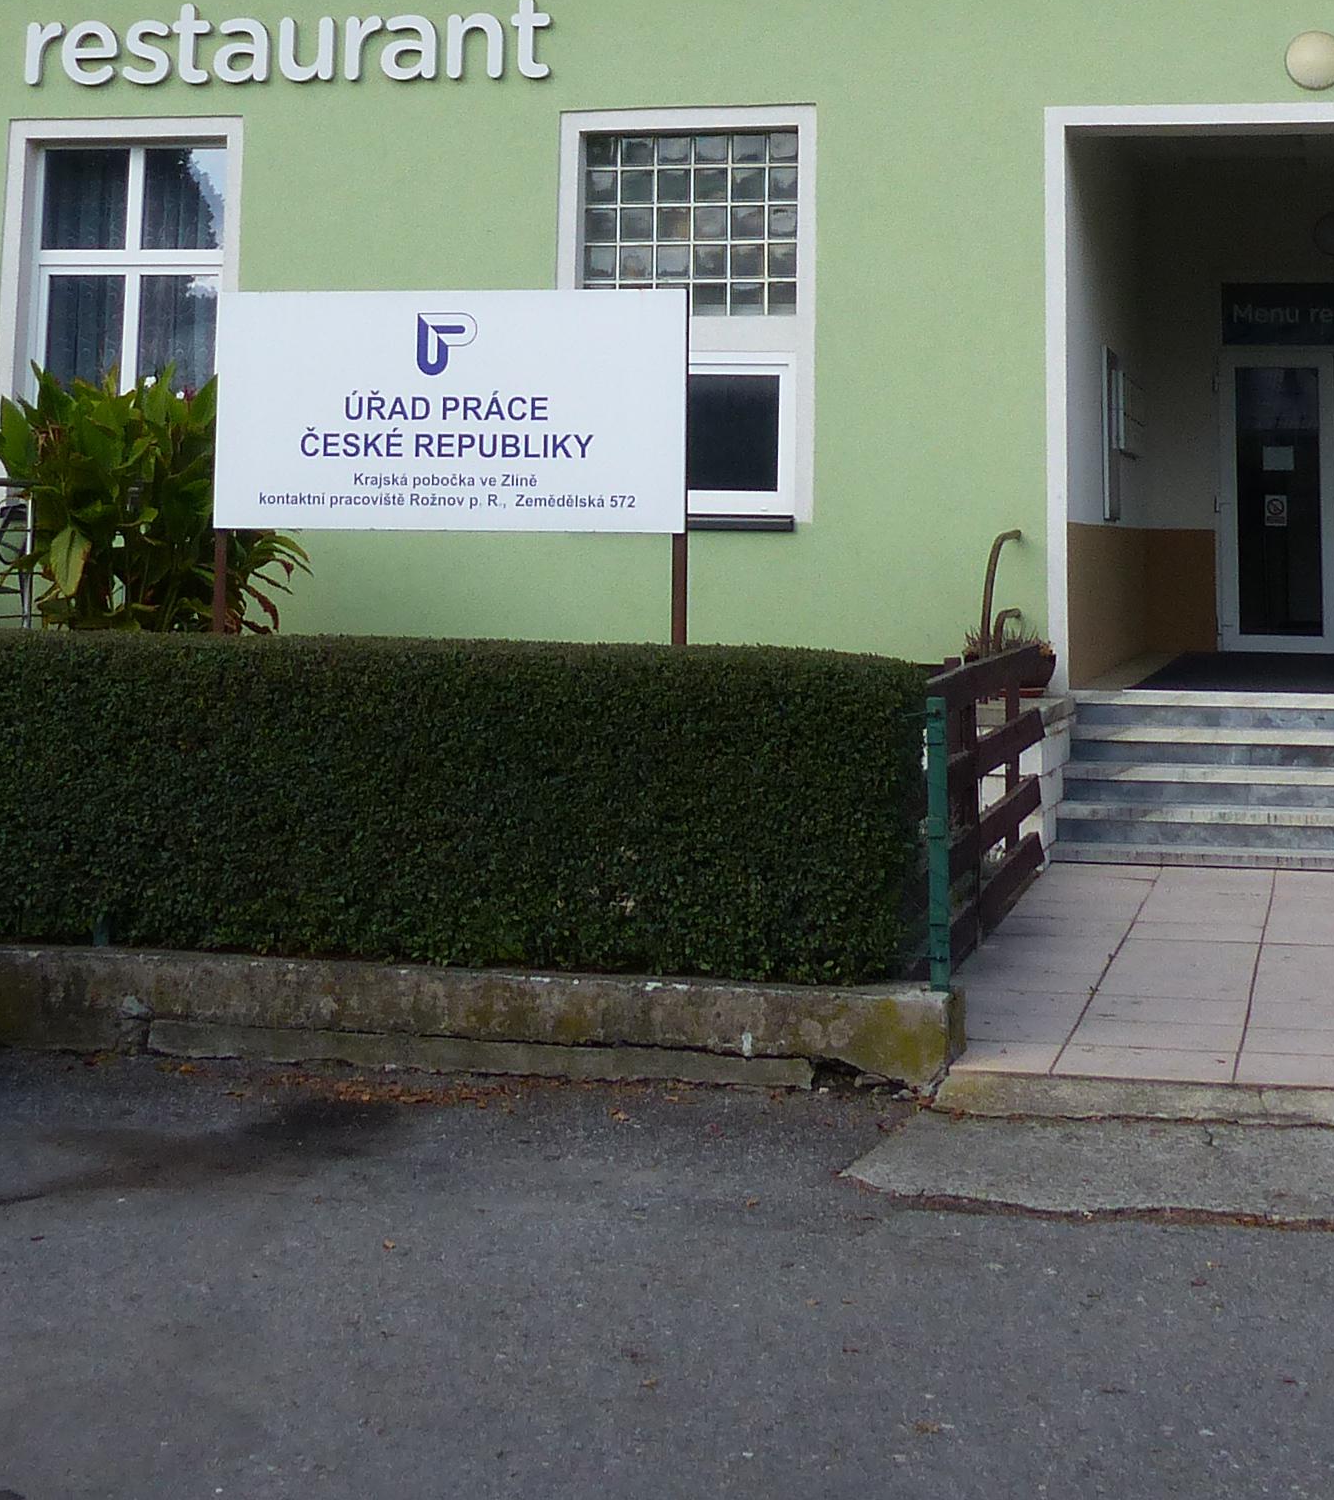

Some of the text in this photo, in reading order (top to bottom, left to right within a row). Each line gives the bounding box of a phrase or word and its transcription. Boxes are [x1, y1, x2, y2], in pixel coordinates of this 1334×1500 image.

[1232, 304, 1300, 324] Menu
[344, 389, 549, 421] ÚŘAD PRÁCE
[300, 426, 594, 459] ČESKÉ REPUBLIKY
[353, 473, 538, 489] Krajská pobočka ve Zlíně
[259, 492, 325, 505] kontaktní
[330, 493, 405, 508] pracoviště
[410, 493, 465, 507] Rožnov
[515, 494, 605, 508] Zemědělská
[610, 495, 636, 508] 572
